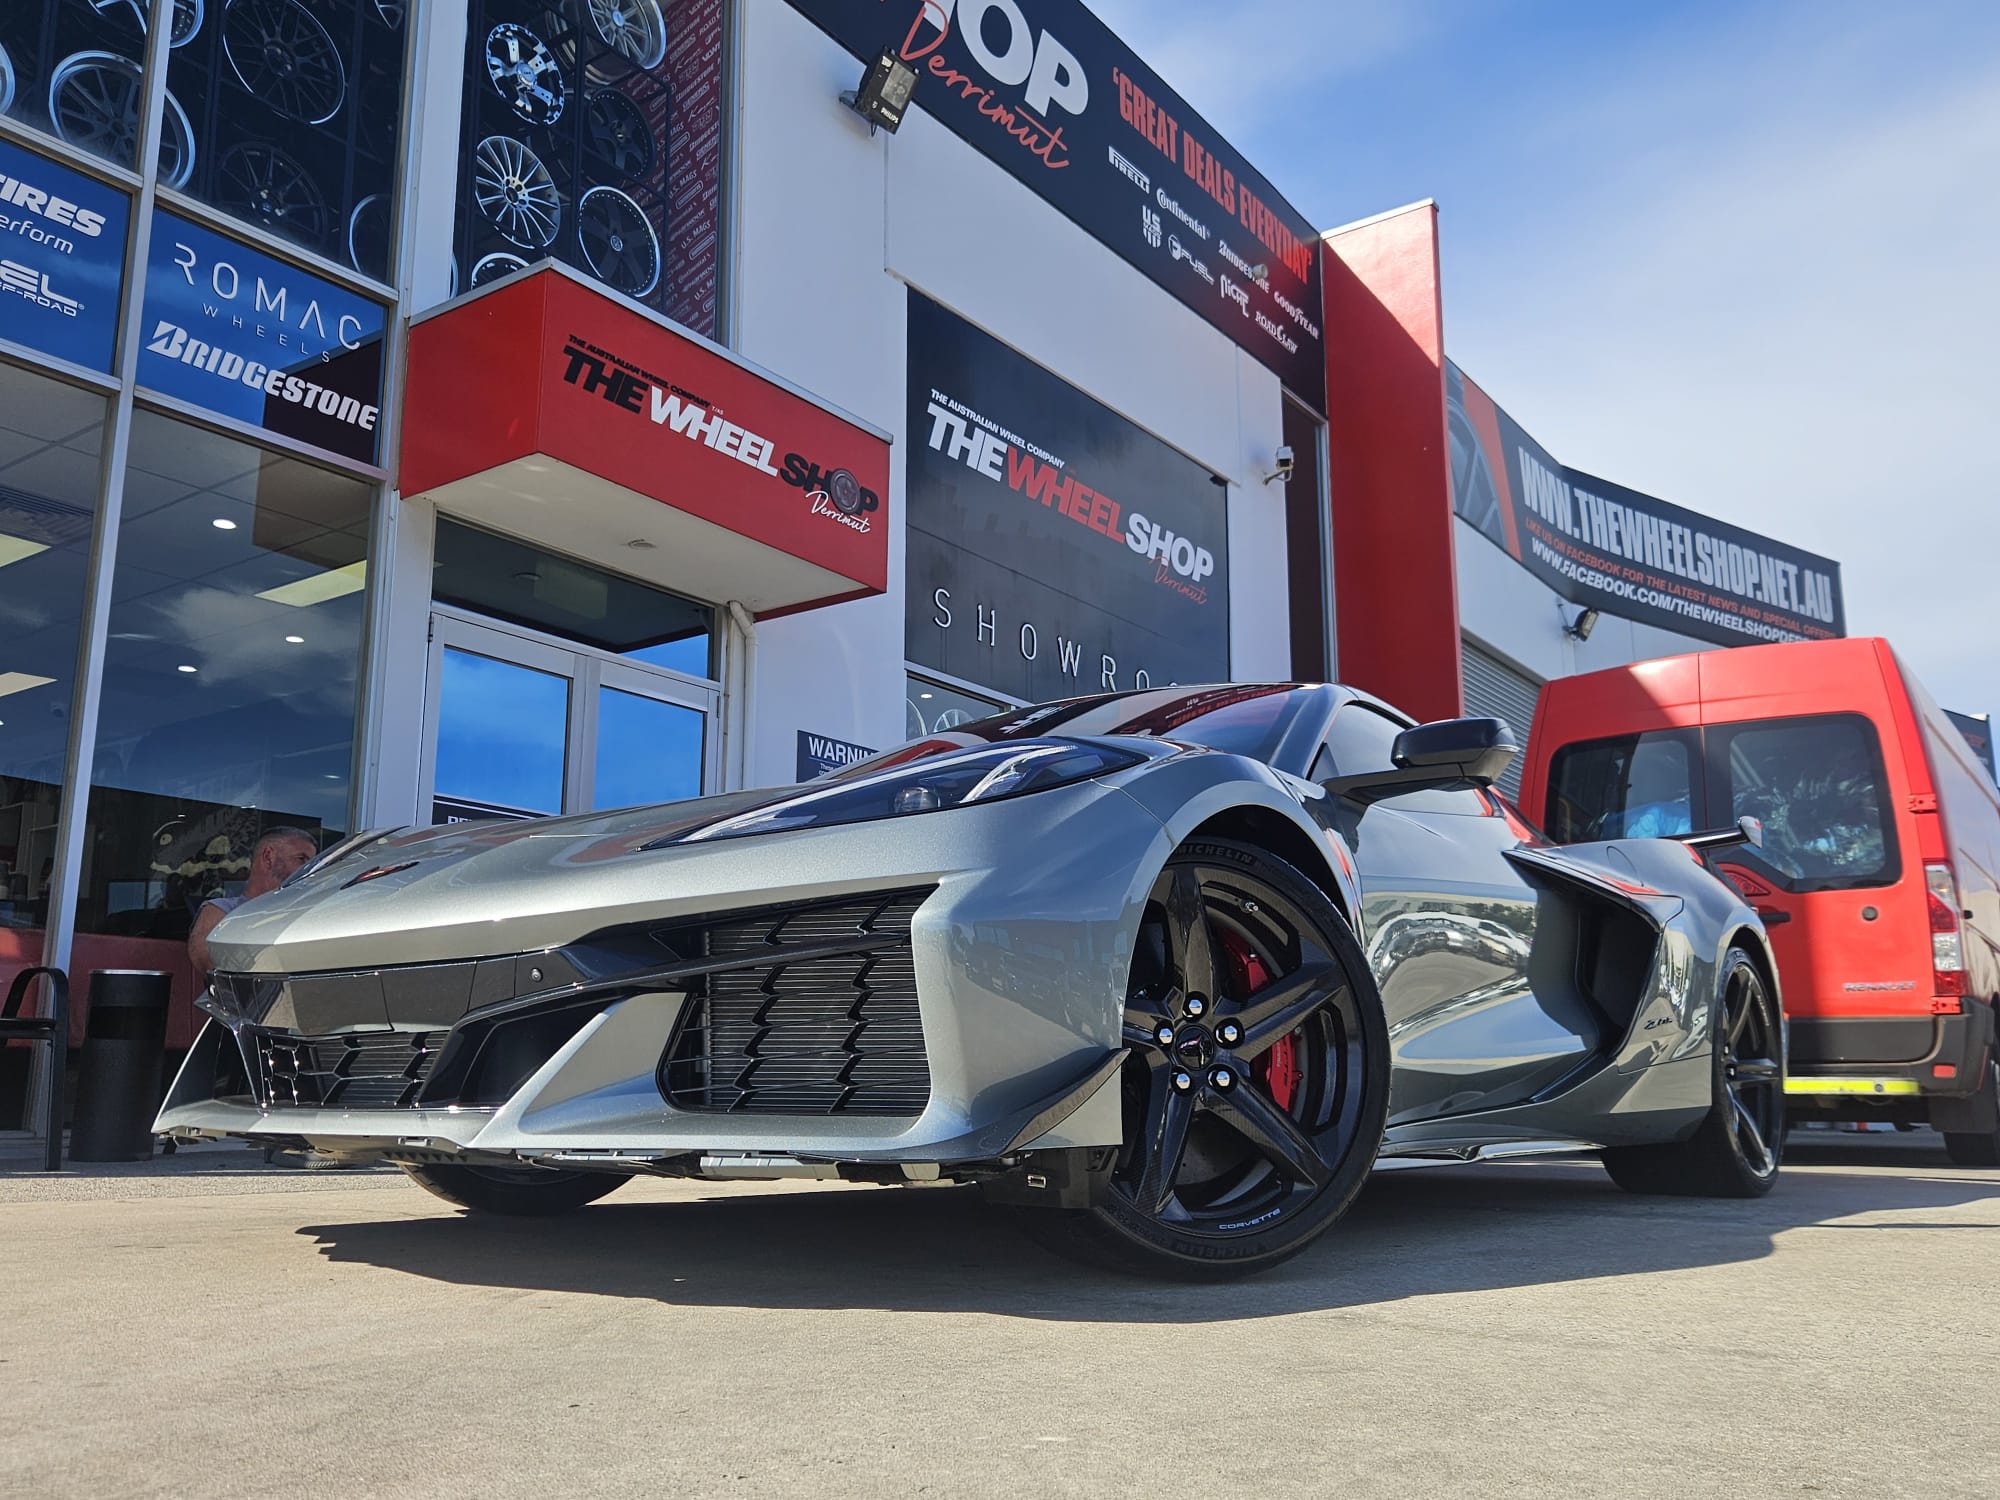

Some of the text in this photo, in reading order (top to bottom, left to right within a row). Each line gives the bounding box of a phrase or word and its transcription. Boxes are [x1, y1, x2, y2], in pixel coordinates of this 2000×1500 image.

[881, 106, 899, 124] PHILIPS
[1108, 145, 1151, 194] PIRELLI
[1183, 130, 1236, 216] DEALS
[1156, 187, 1207, 240] Continental
[174, 242, 362, 350] ROMAC
[1273, 291, 1319, 340] GOODYEAR
[203, 303, 331, 364] WHEELS
[146, 320, 379, 431] BRIDGESTONE
[569, 334, 587, 349] THE
[586, 344, 641, 375] AUSTRALIAN
[641, 369, 670, 390] WHEEL
[670, 384, 711, 408] COMPANY
[564, 345, 649, 414] THE
[650, 385, 778, 477] WHEEL
[930, 388, 1065, 469] THE AUSTRALIAN WHEEL COMPANY
[805, 490, 871, 534] Derrimut
[927, 401, 1214, 582] THE WHEEL SHOP
[1518, 446, 1834, 624] WWW.THEWHEELSHOP.NET.AU
[1565, 545, 1621, 576] FACEBOOK
[1622, 567, 1644, 584] FOR
[1646, 575, 1666, 590] THE
[1667, 582, 1707, 601] LATEST
[1707, 594, 1739, 612] NEWS
[1739, 604, 1762, 620] AND
[1762, 611, 1801, 632] SPECIAL
[1843, 981, 1916, 992] RENAULT
[1219, 1208, 1280, 1229] CORVETTE
